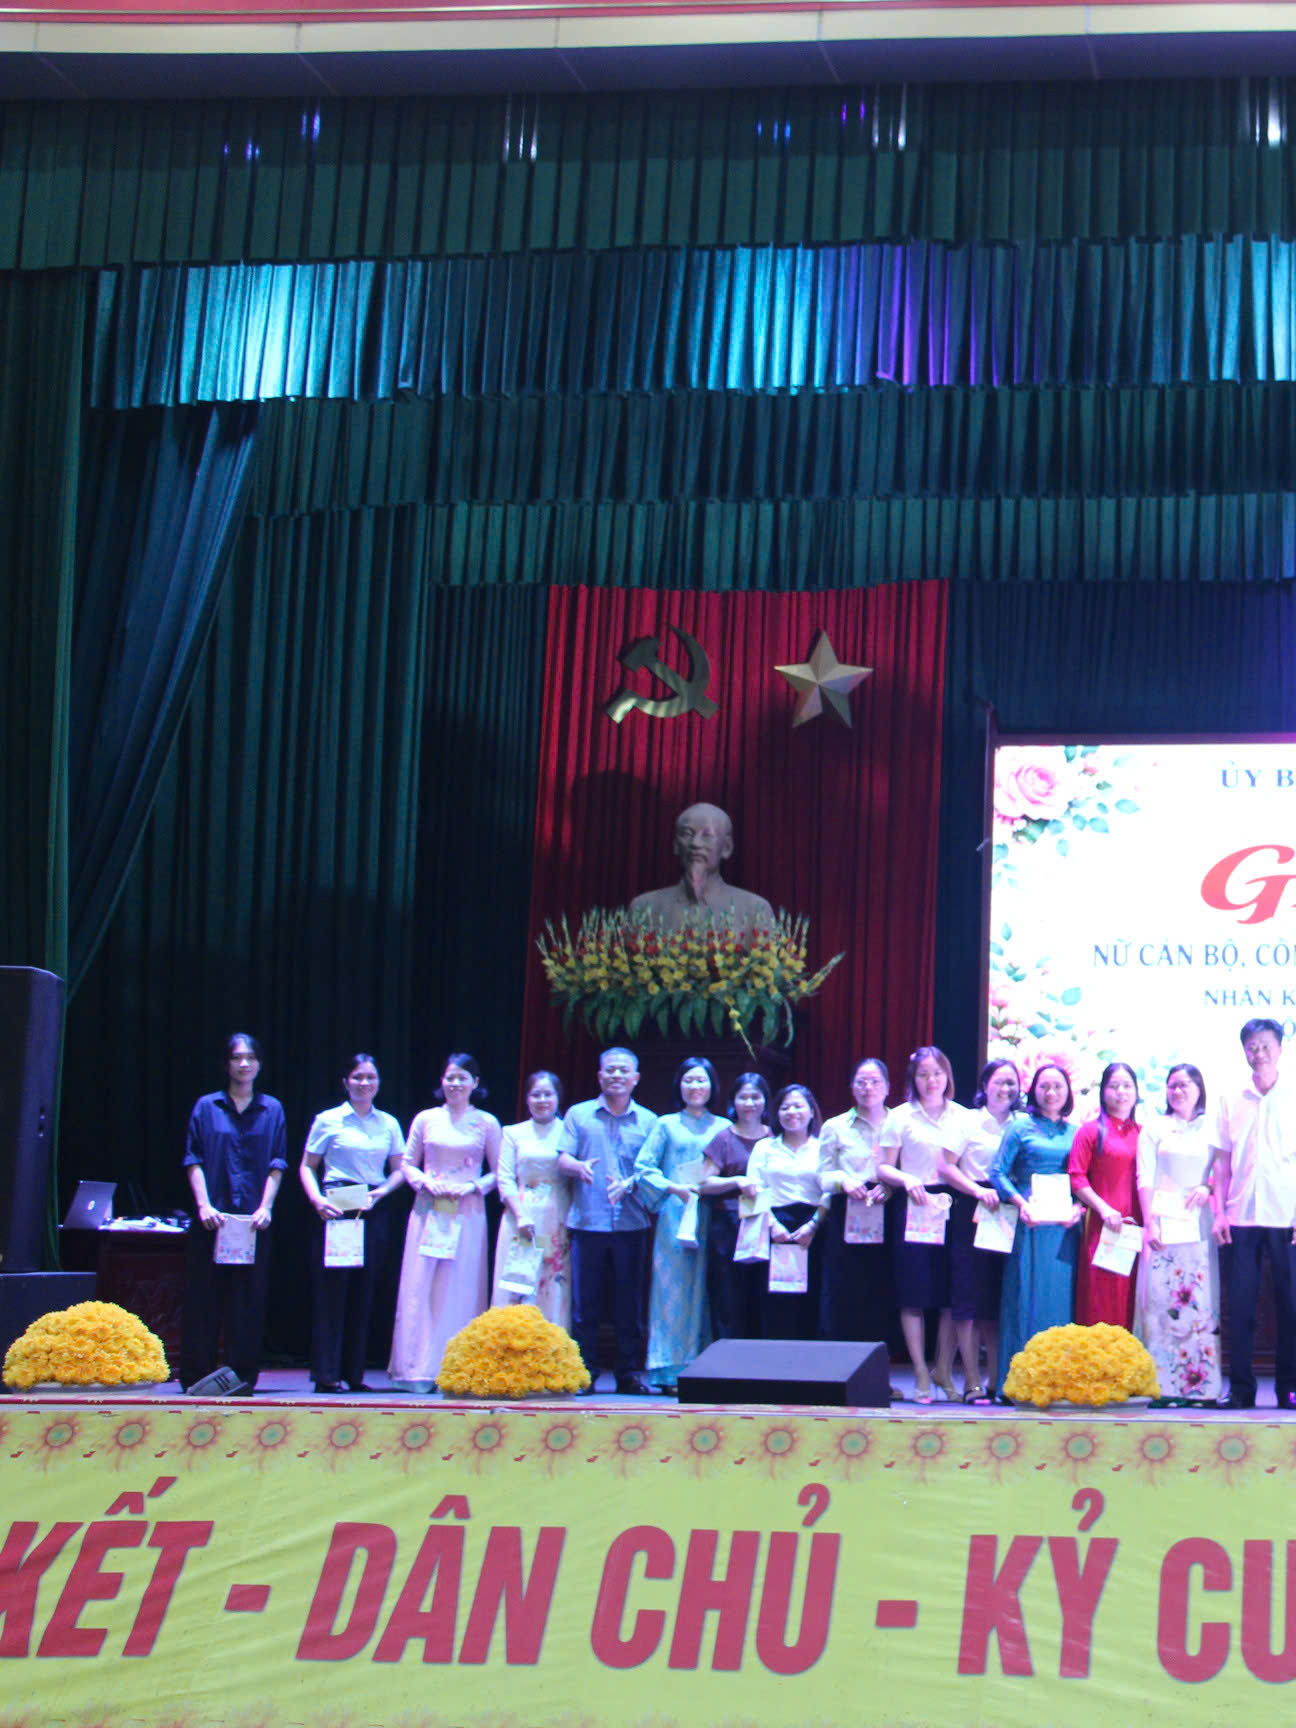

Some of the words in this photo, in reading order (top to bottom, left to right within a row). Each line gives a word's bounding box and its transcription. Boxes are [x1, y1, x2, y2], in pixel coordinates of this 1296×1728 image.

[1093, 938, 1132, 967] NỮ
[0, 1476, 215, 1659] KẾT
[223, 1584, 272, 1613] -
[294, 1494, 566, 1665] DÂN
[590, 1482, 841, 1675] CHỦ
[875, 1600, 919, 1628] -
[956, 1487, 1119, 1679] KỶ
